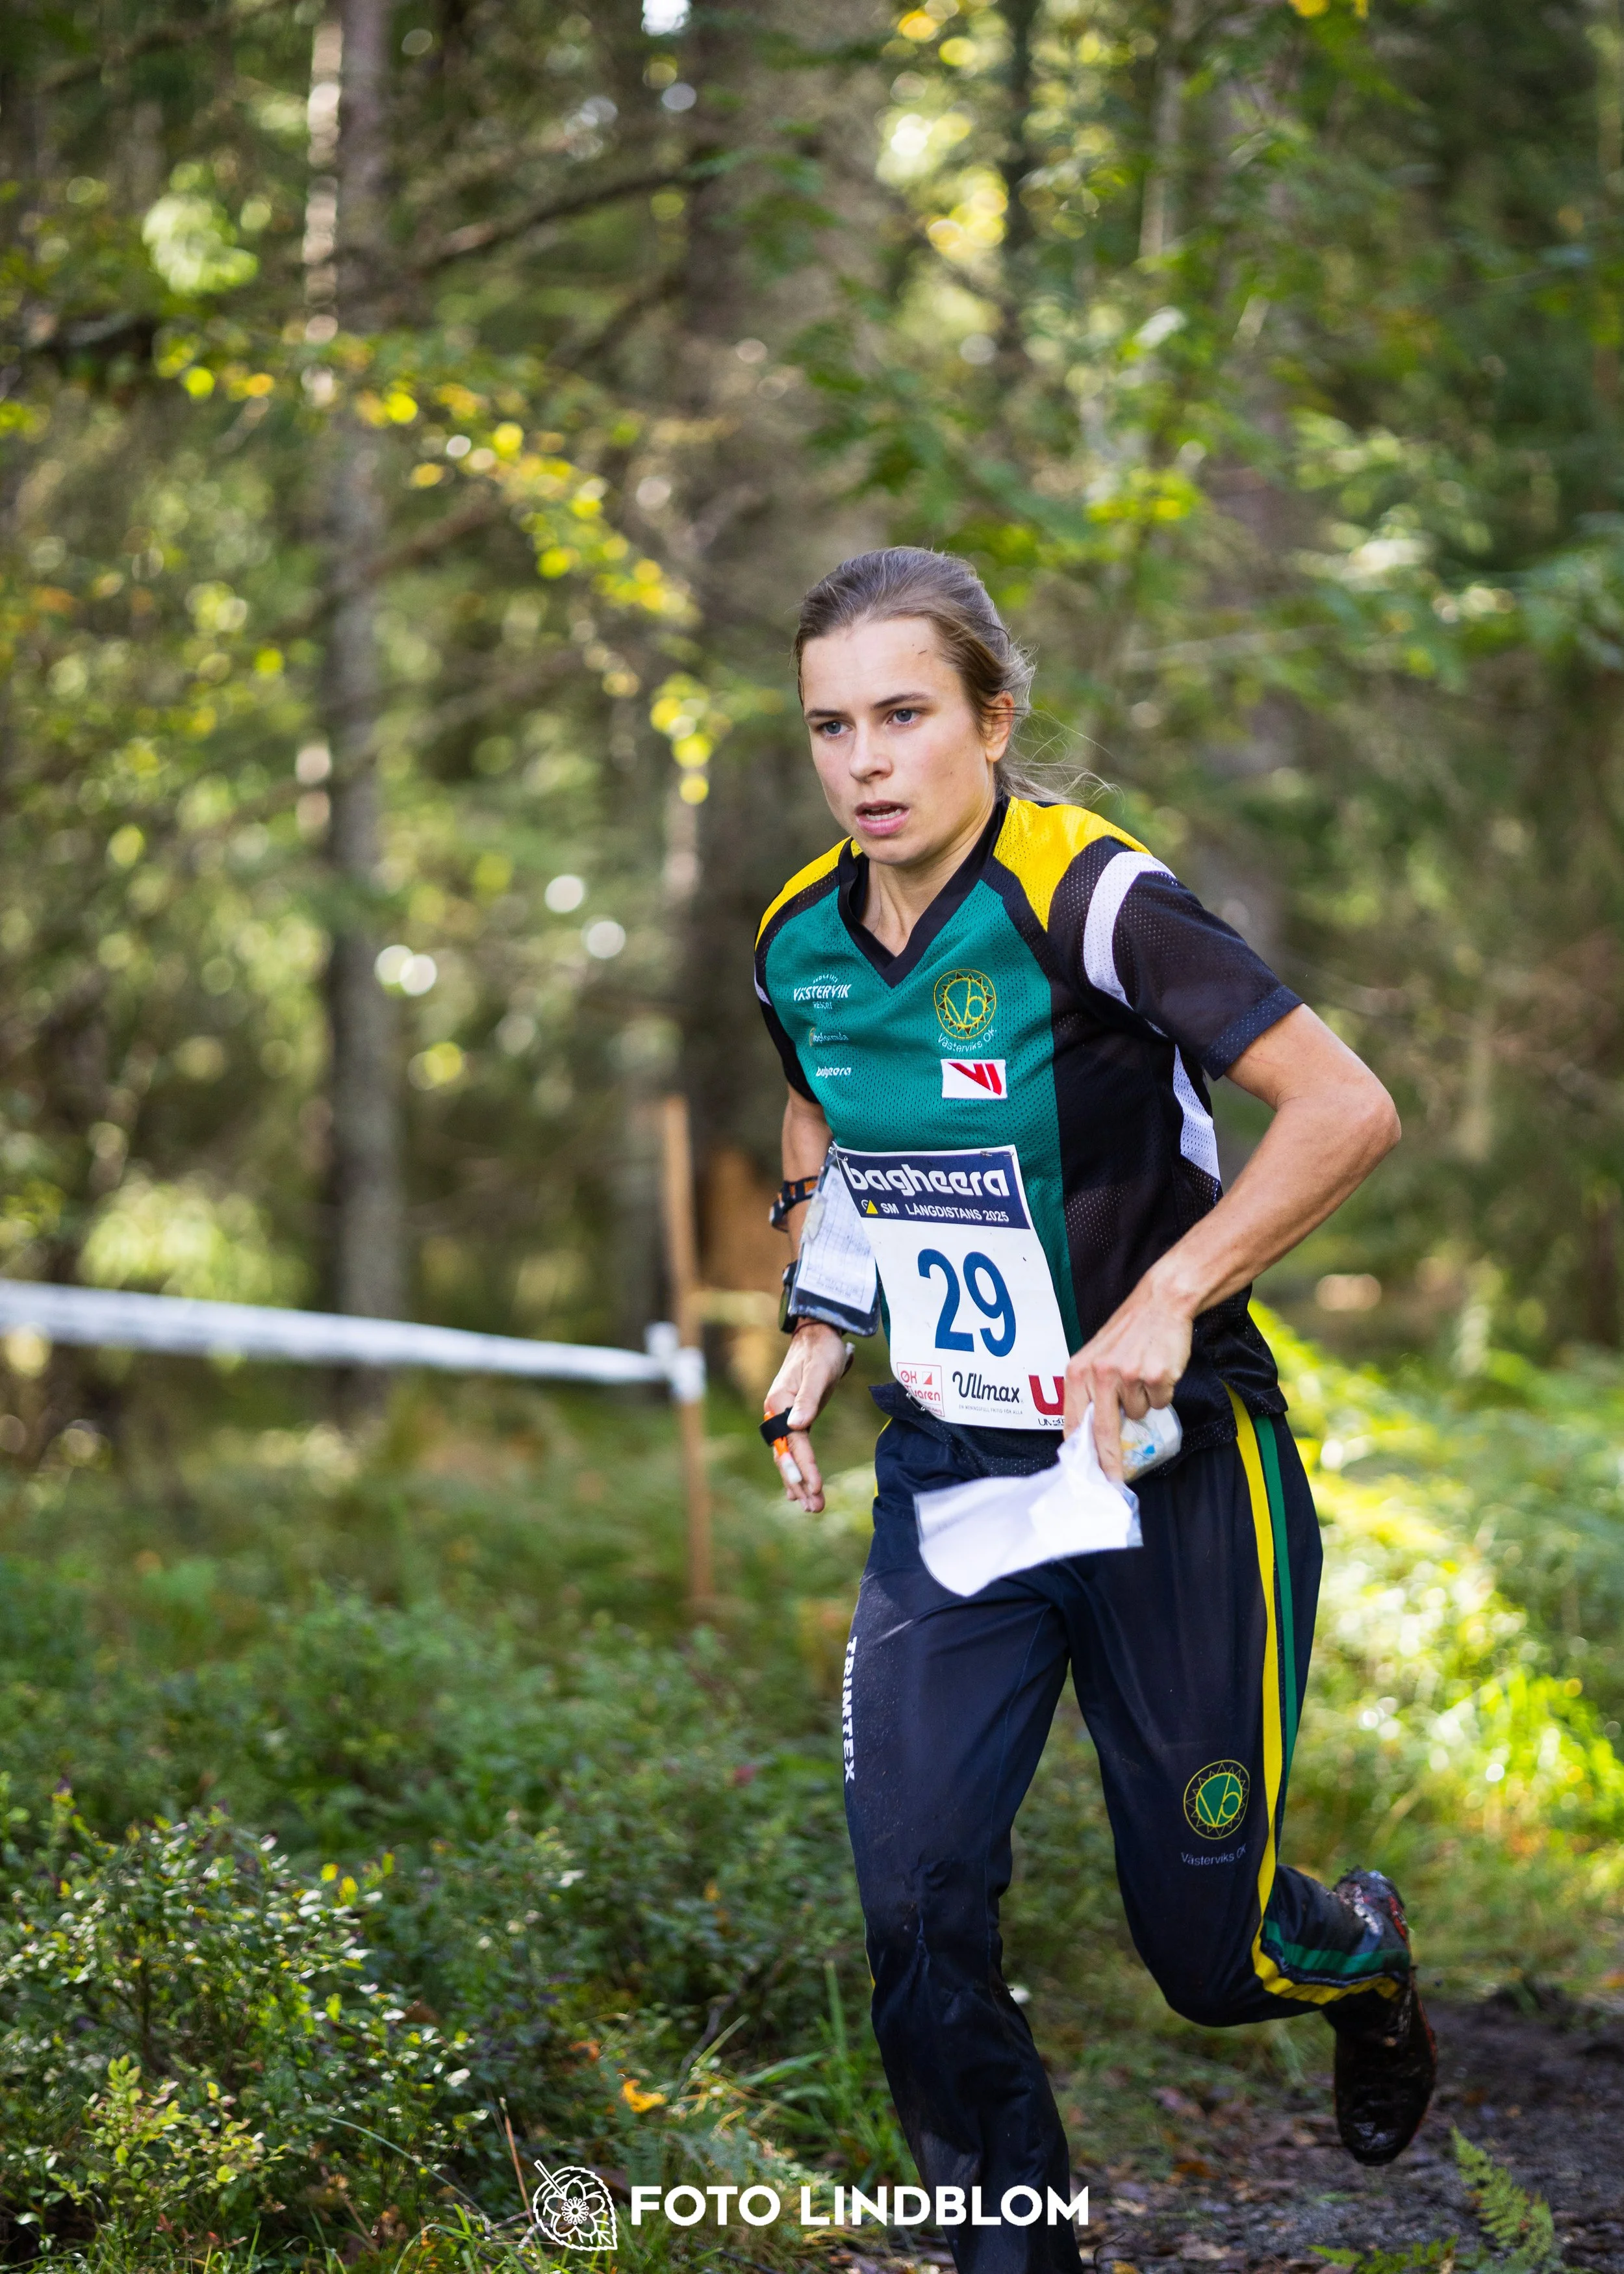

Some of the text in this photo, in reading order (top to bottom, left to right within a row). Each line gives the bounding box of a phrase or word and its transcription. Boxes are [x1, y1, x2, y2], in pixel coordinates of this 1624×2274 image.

[793, 984, 852, 1001] VÄSTERVIK
[938, 1032, 983, 1052] Västerviks
[843, 1160, 1010, 1196] bagheera
[881, 1201, 1009, 1222] SM LÅNGDISTANS 2025
[917, 1248, 1017, 1357] 29
[952, 1371, 1020, 1403] Ullmax
[843, 1636, 857, 1783] TRIMTEX
[1181, 1852, 1234, 1865] Västerviks
